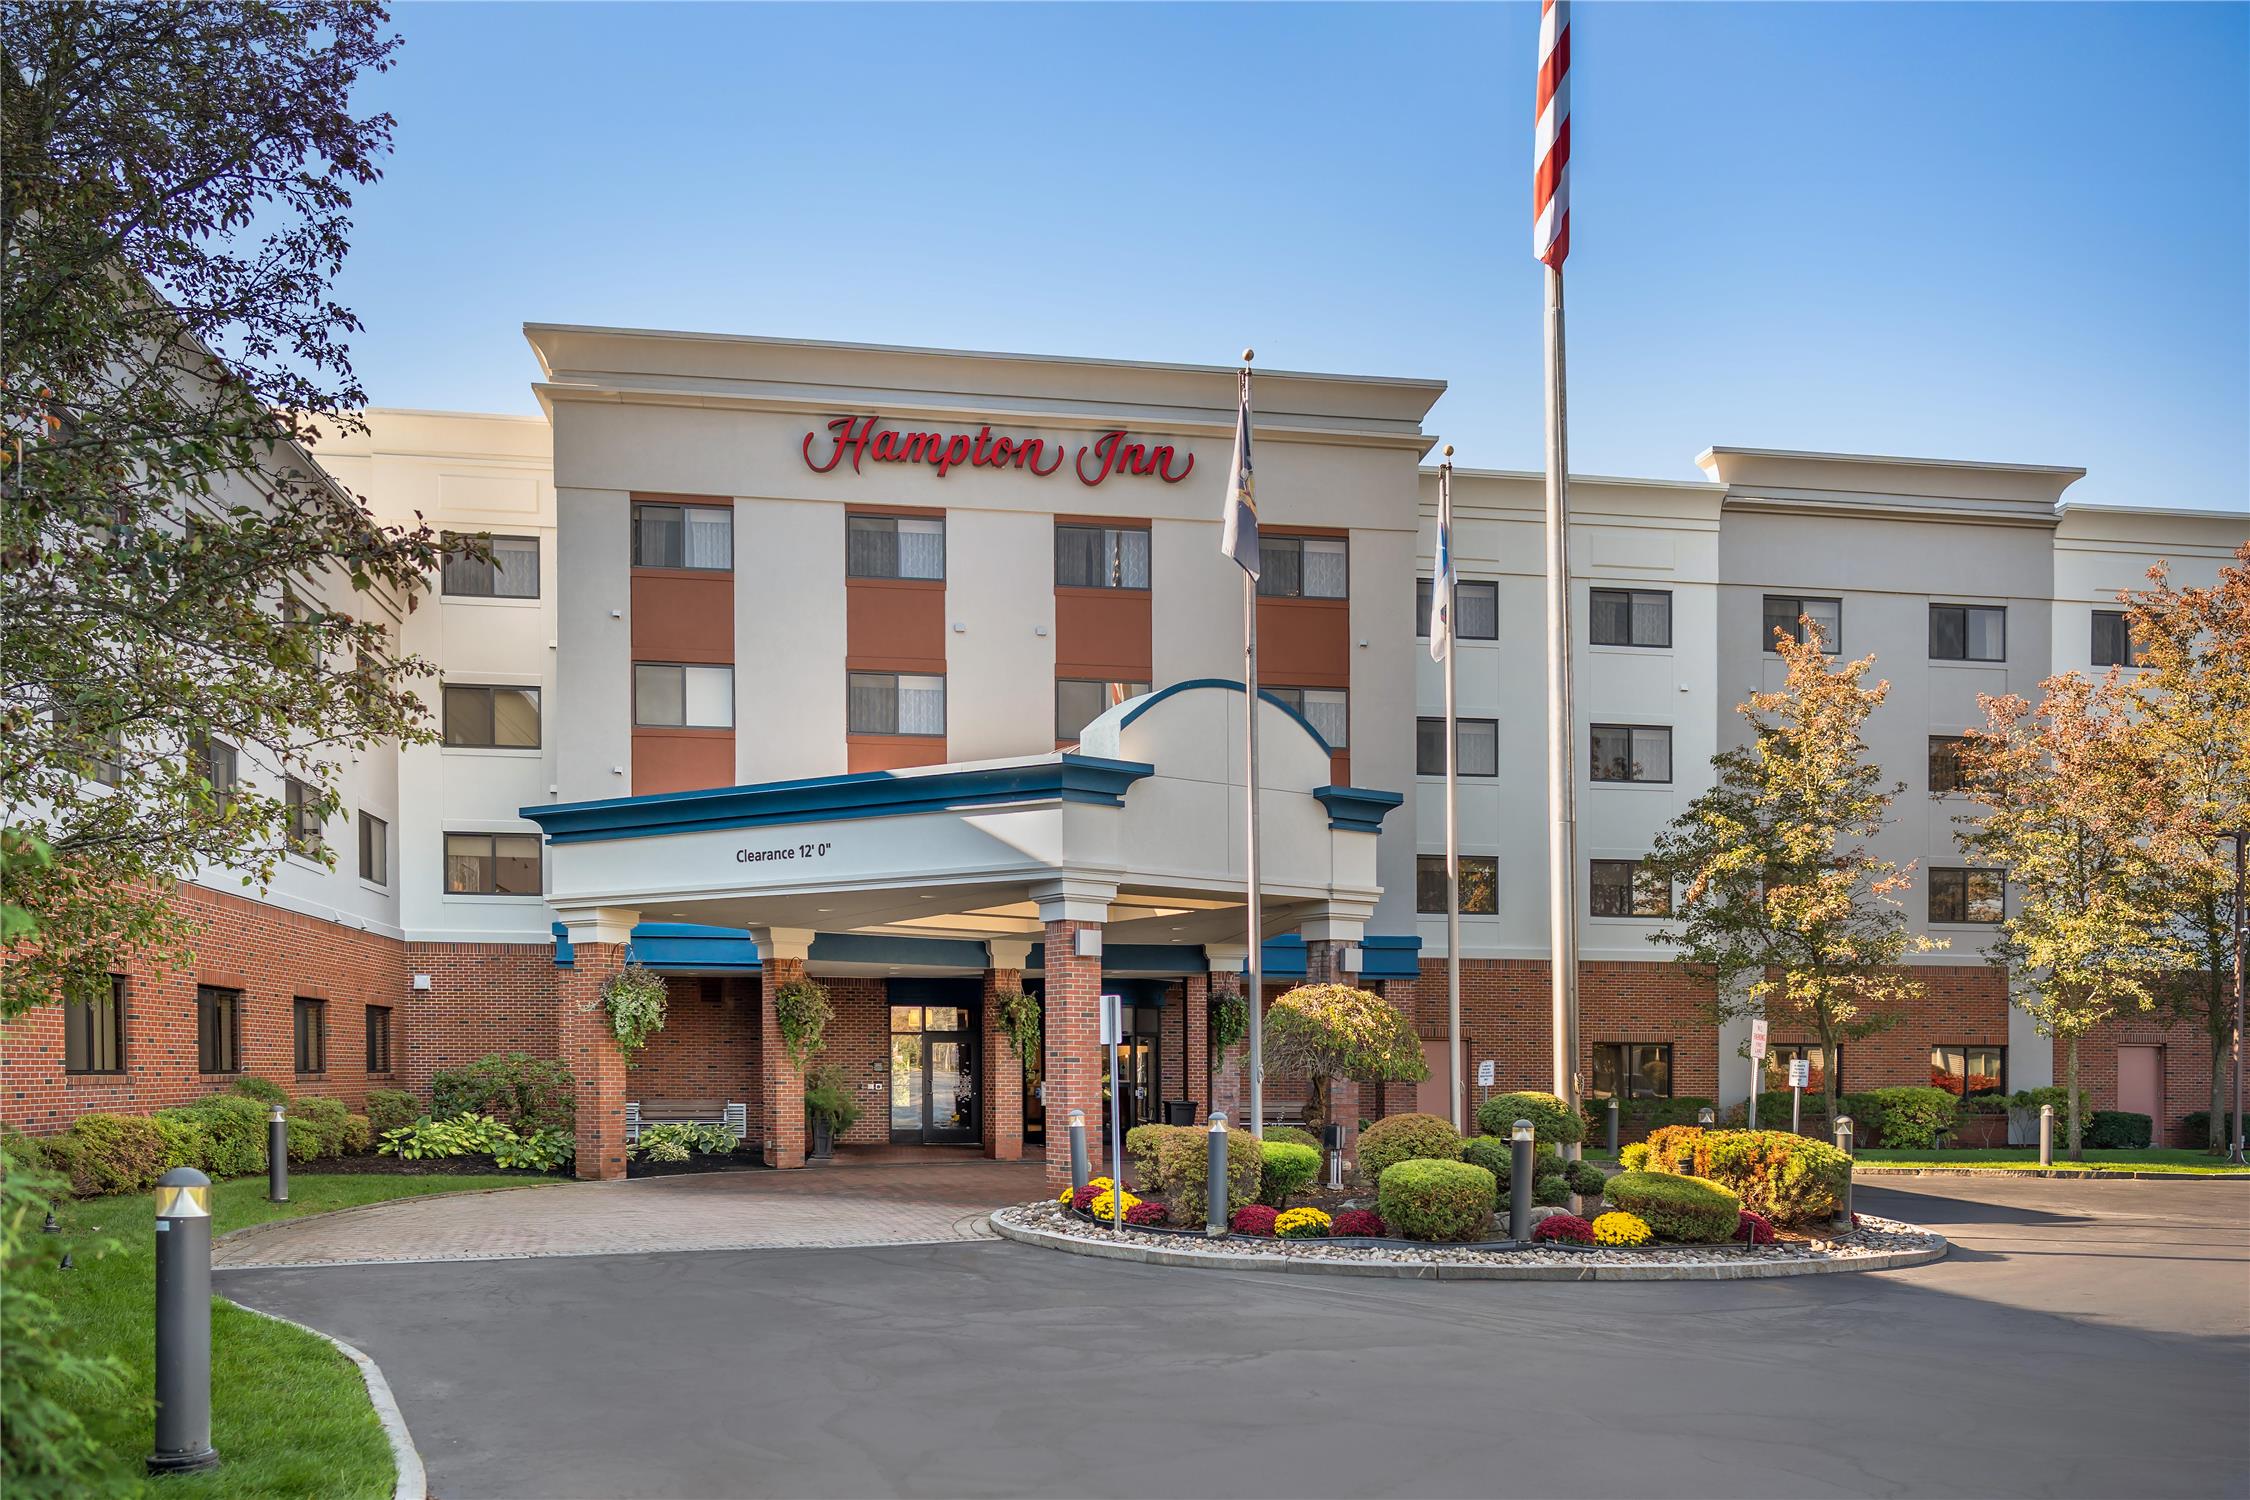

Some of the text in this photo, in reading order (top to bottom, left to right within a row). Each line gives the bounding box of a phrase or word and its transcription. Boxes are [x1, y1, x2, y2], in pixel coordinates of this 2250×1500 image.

[802, 415, 1194, 487] Hampton Inn
[736, 843, 831, 863] Clearance 12' 0"
